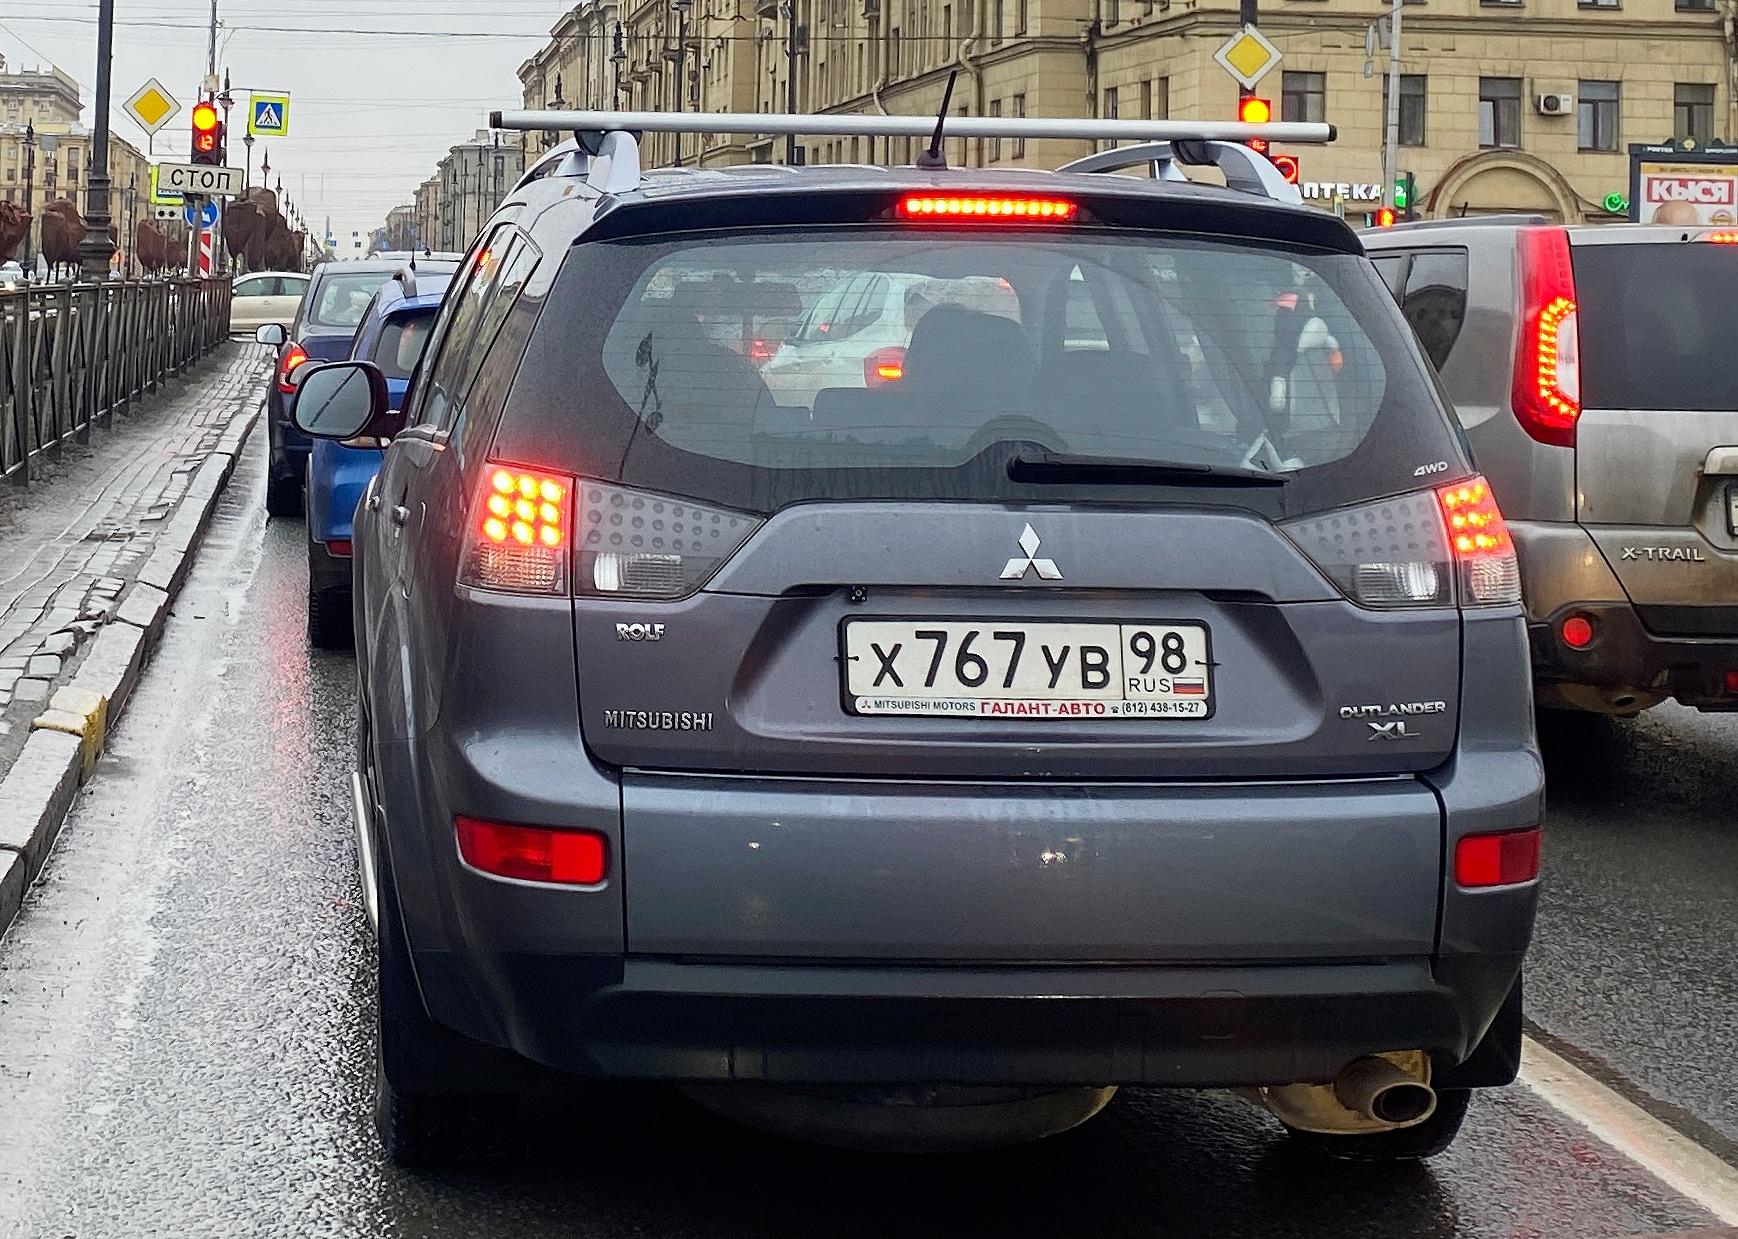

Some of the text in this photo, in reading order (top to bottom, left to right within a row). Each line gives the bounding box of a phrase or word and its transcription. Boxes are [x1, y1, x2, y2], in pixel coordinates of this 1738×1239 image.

[201, 136, 214, 151] 12
[171, 169, 231, 190] СТОП
[1299, 182, 1385, 200] ПТЕКА
[1651, 180, 1730, 203] КЫСЯ
[1413, 461, 1448, 477] 4WD
[1621, 546, 1705, 561] X-TRAIL
[615, 622, 665, 641] ROLF
[1130, 631, 1187, 675] 98
[1128, 677, 1171, 693] RUS
[874, 700, 1200, 716] MITSUBISHI MOTORS ГАЛАНТ-АВТО (812) 438-15-27
[1340, 701, 1446, 719] OUTLANDER
[604, 710, 713, 731] MITSUBISHI
[1367, 721, 1421, 741] XL
